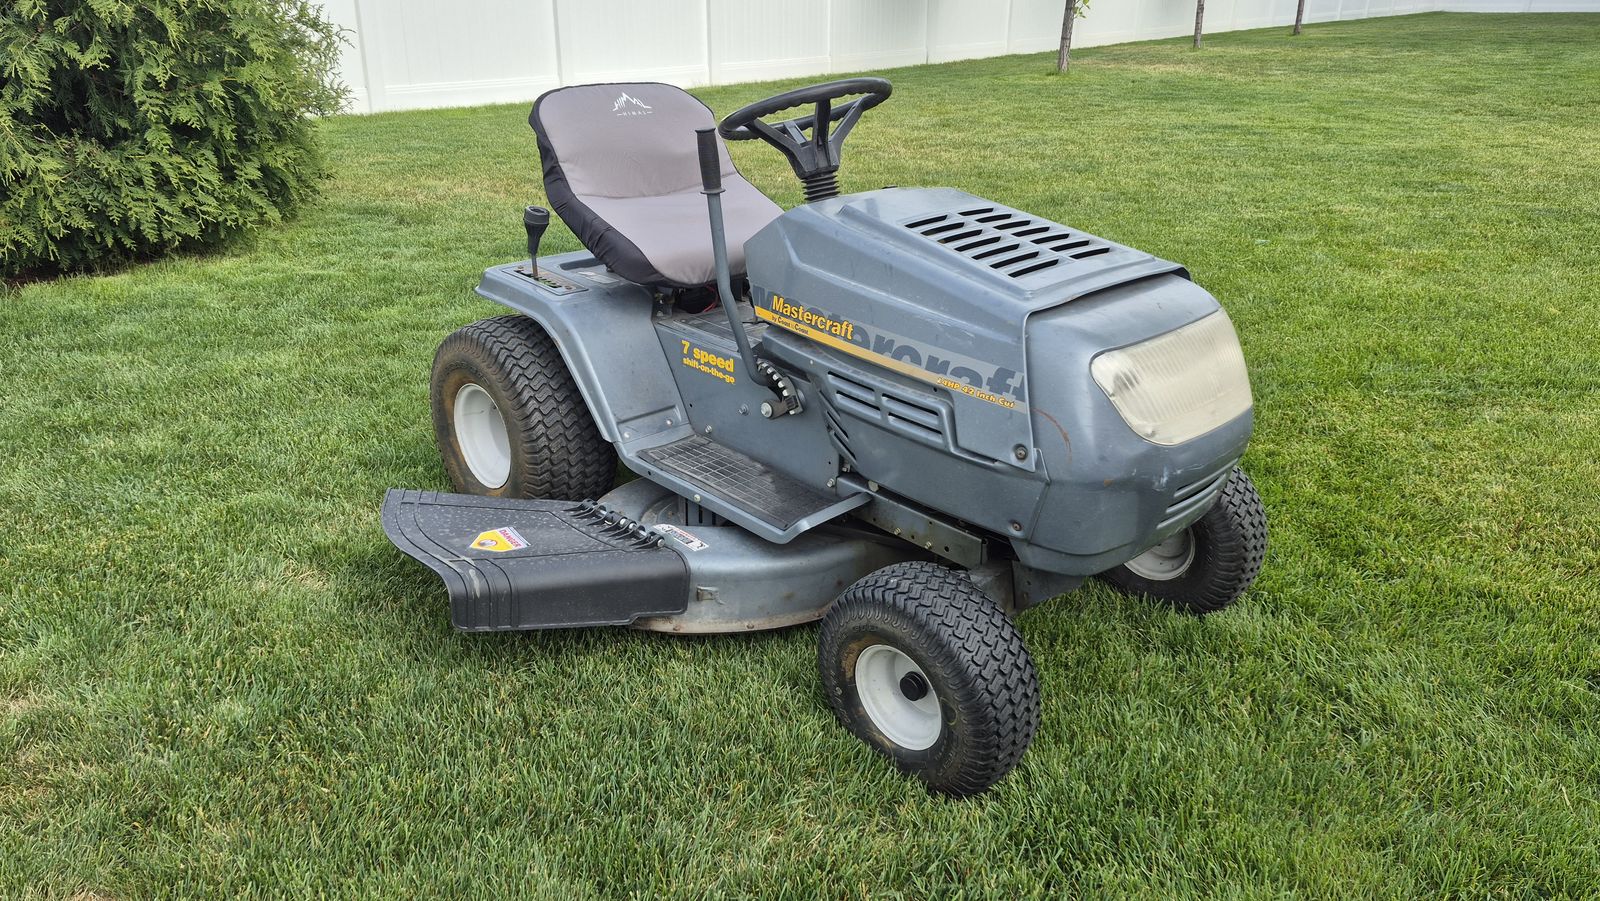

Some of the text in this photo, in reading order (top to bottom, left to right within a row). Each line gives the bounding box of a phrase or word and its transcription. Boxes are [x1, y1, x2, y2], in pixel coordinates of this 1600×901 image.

[772, 294, 854, 341] Mastercraft
[681, 339, 735, 373] 7 speed
[682, 357, 736, 385] shift-on-the-go
[961, 385, 976, 397] 42
[976, 390, 997, 403] Inch
[998, 396, 1016, 410] Cut
[499, 529, 522, 547] DANGER
